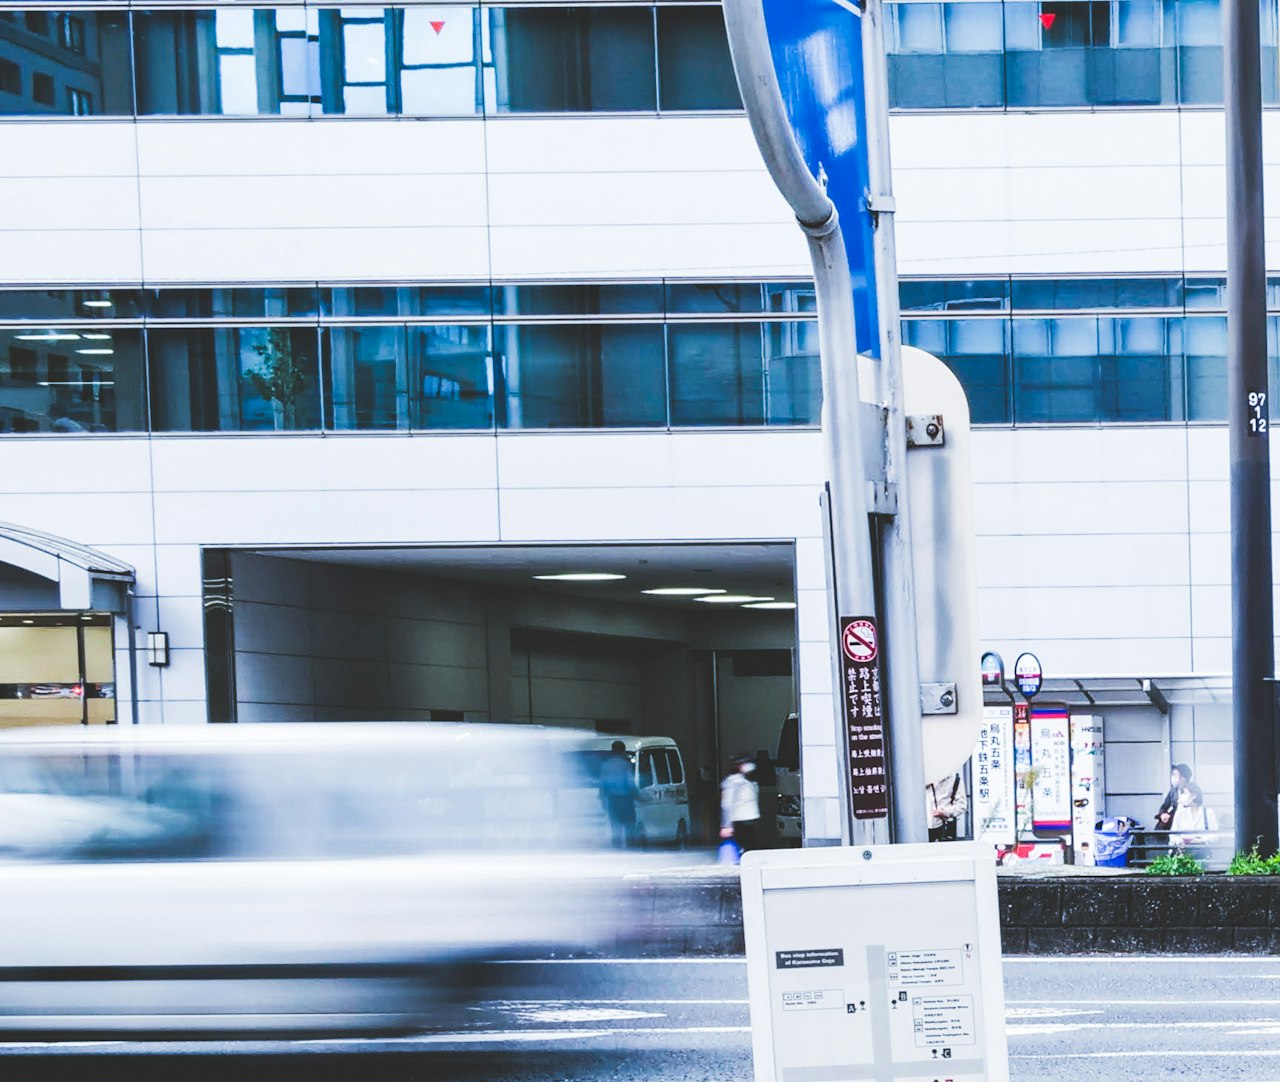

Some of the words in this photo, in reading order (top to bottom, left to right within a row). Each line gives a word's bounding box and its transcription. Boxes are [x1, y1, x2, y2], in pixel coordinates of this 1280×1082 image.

[1248, 392, 1266, 406] 97
[1254, 406, 1261, 419] 1
[1249, 418, 1267, 432] 12
[847, 667, 859, 718] 禁止です
[859, 667, 873, 717] 路上喫煙
[990, 724, 1001, 769] 烏丸五条
